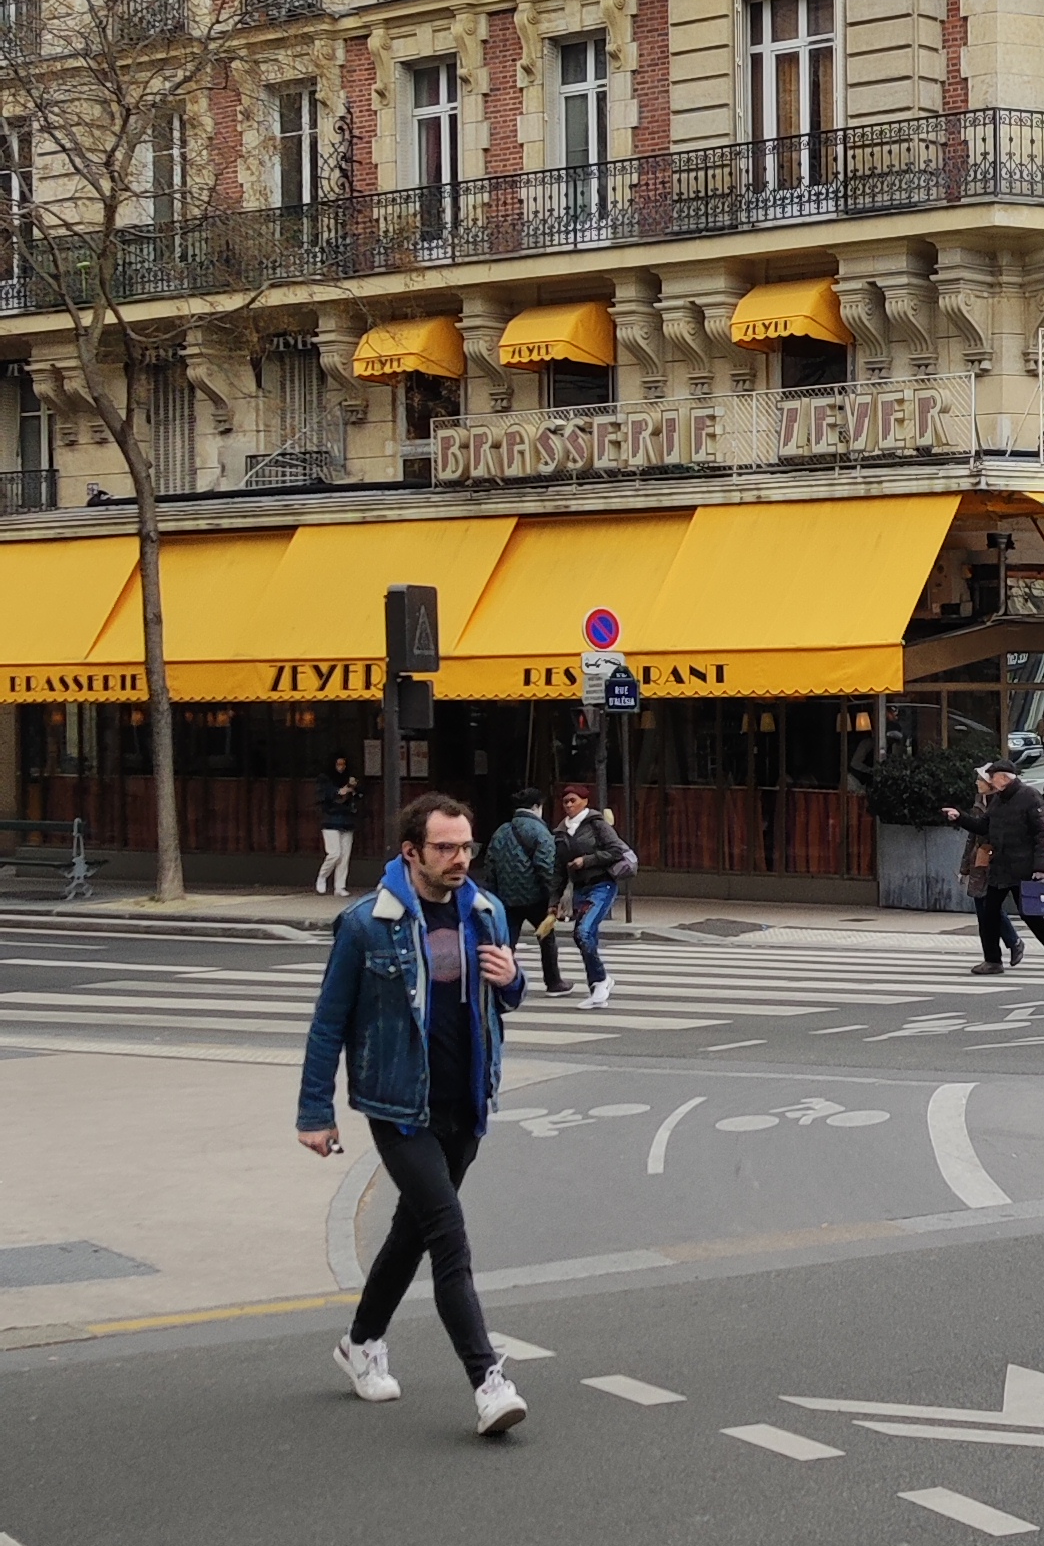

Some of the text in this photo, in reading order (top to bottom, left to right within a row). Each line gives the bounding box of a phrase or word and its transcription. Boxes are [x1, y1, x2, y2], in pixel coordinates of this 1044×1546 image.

[743, 319, 793, 337] ZEYER
[509, 343, 554, 360] ZEYER
[362, 356, 403, 372] ZEYER
[436, 387, 957, 480] BRASSERIE ZEYER
[9, 662, 730, 693] BRASSERIE ZEYER RESRANT
[614, 685, 629, 695] RUE
